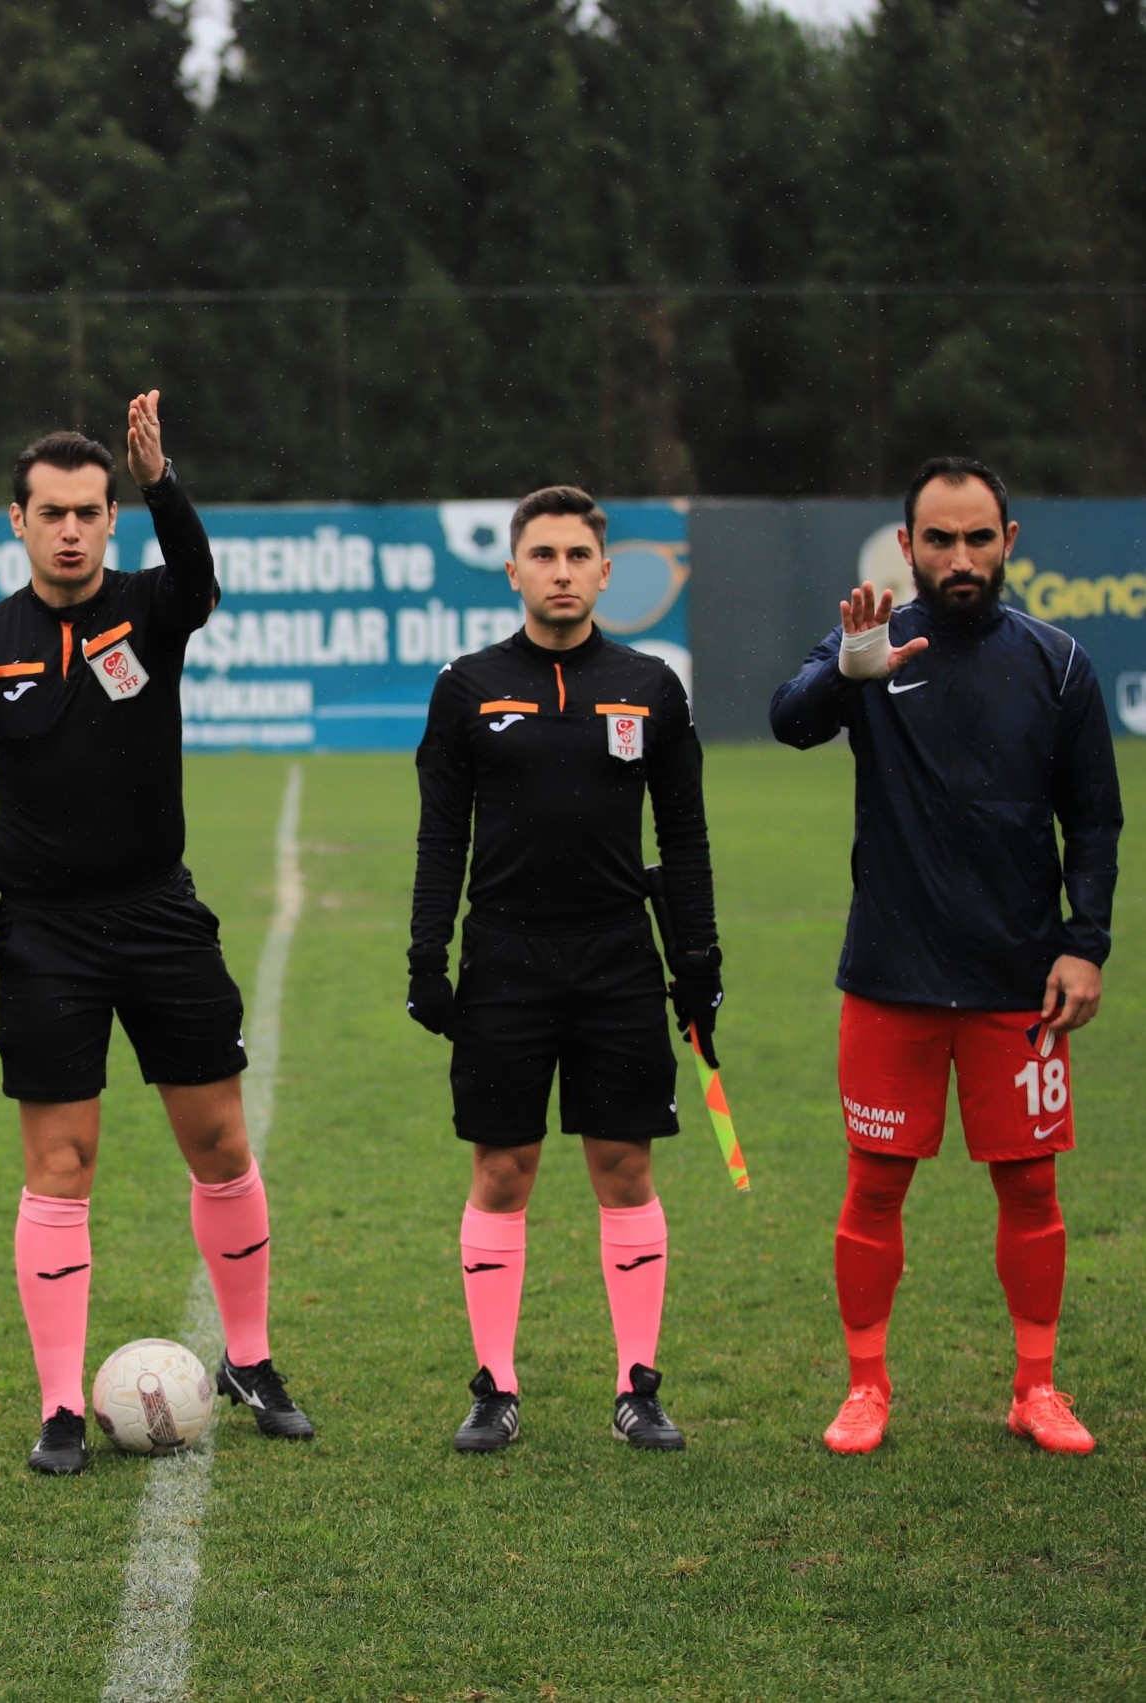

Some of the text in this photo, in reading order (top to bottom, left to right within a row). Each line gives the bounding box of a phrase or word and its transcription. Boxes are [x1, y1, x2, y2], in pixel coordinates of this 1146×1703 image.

[379, 543, 434, 589] ve
[115, 674, 139, 694] TFF
[616, 745, 636, 756] TFF
[1015, 1058, 1067, 1116] 18
